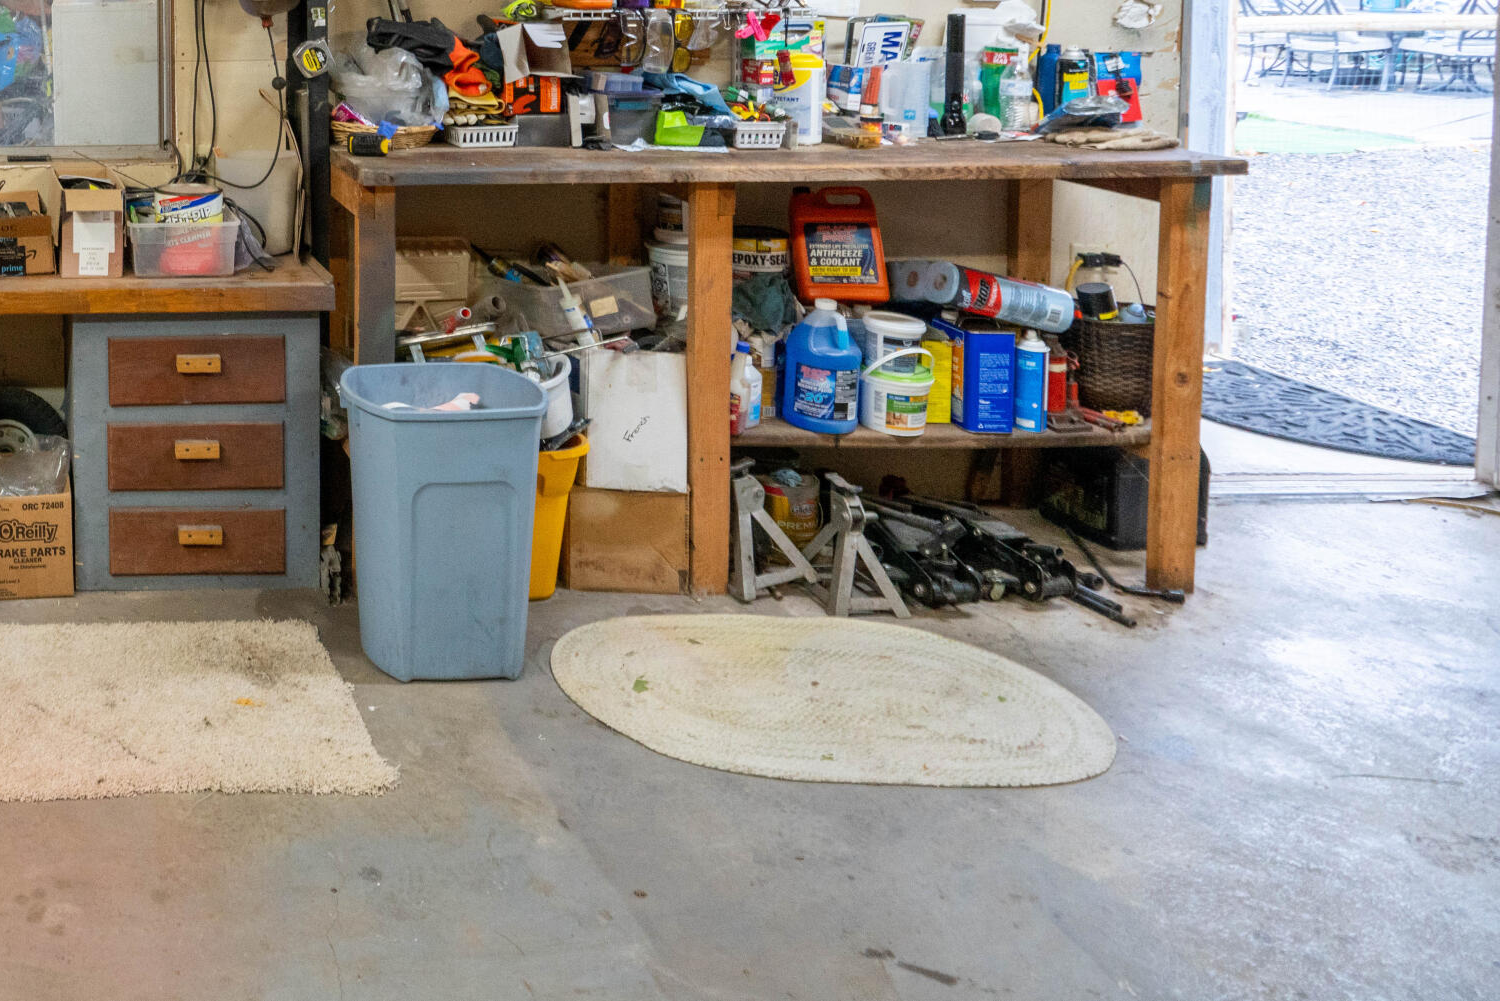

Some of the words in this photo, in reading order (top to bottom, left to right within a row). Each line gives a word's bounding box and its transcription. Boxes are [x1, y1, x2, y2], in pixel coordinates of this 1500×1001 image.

[810, 249, 863, 258] ANTIFREEZE
[811, 258, 818, 266] &
[820, 258, 861, 266] COOLANT
[1, 264, 24, 274] prime
[22, 503, 39, 511] ORC
[41, 501, 64, 510] 72408
[30, 546, 66, 558] PARTS
